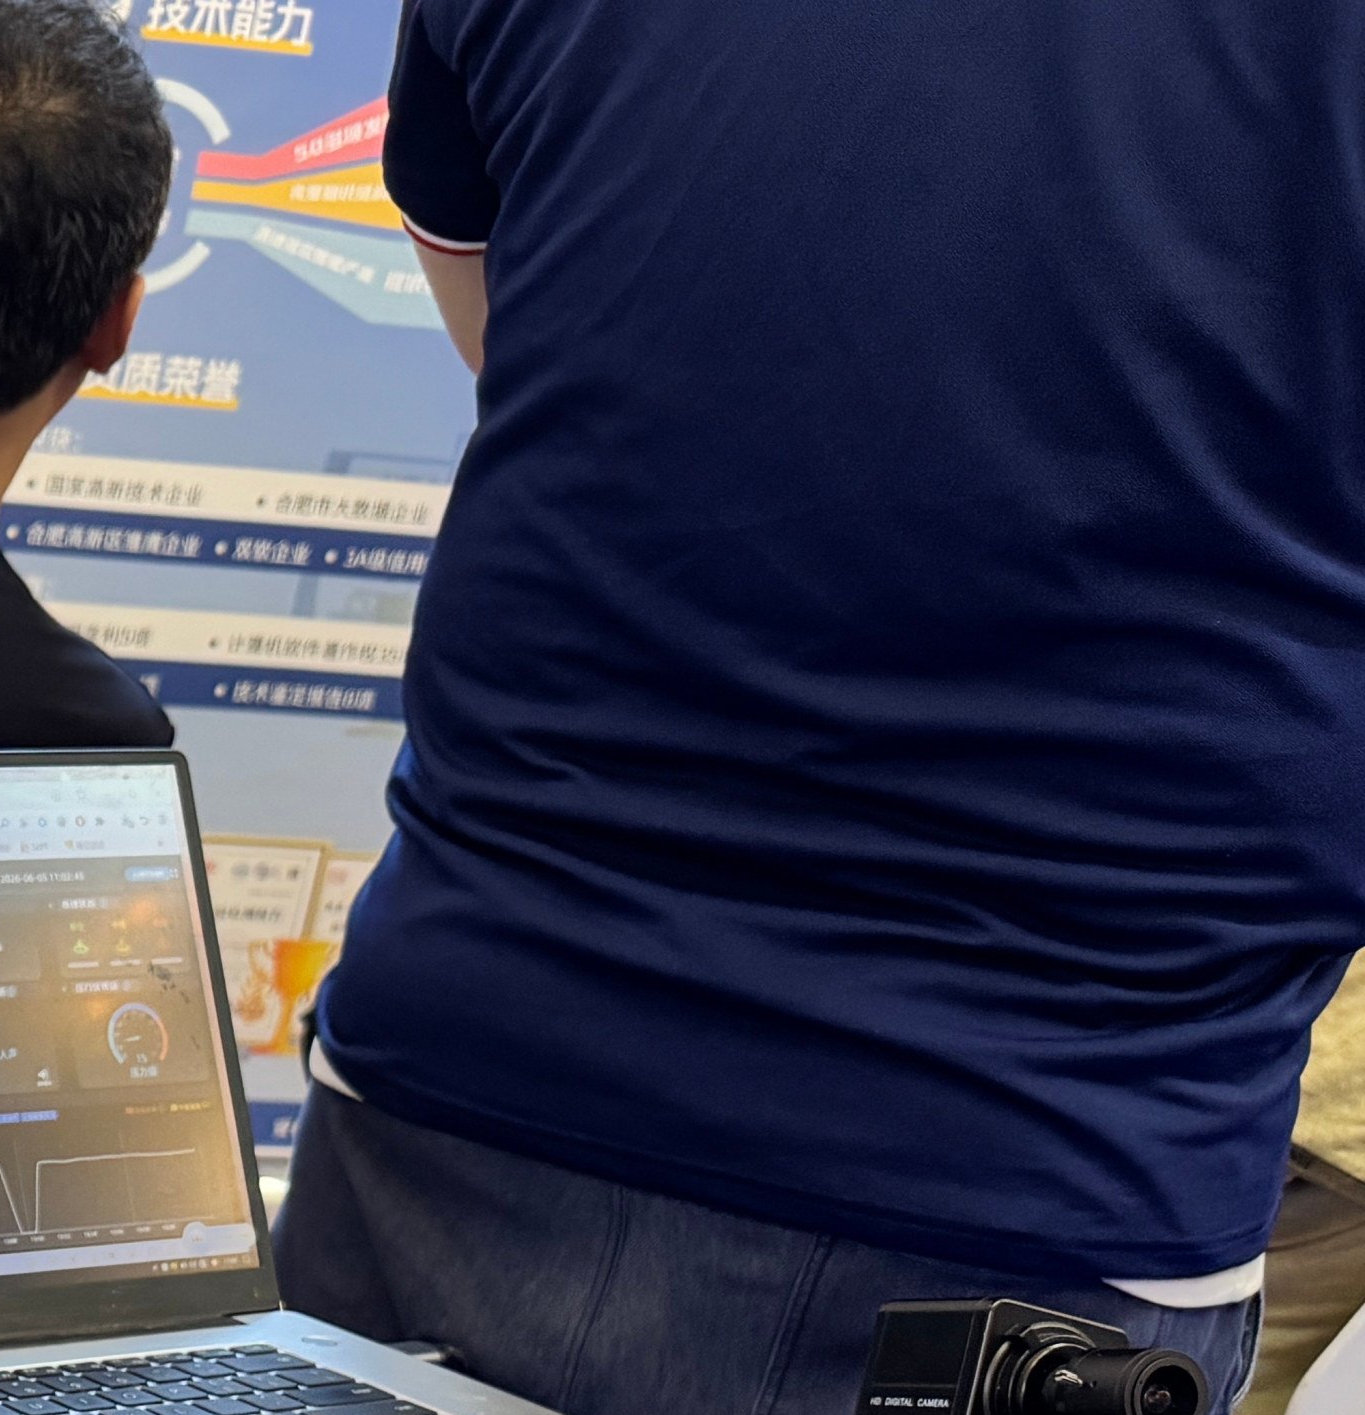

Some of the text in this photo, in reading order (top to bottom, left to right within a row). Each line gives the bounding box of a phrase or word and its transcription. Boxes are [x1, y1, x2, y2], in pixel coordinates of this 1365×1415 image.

[144, 0, 313, 46] 技术能力
[884, 1397, 914, 1408] DIGITAL
[916, 1398, 950, 1409] CAMERA
